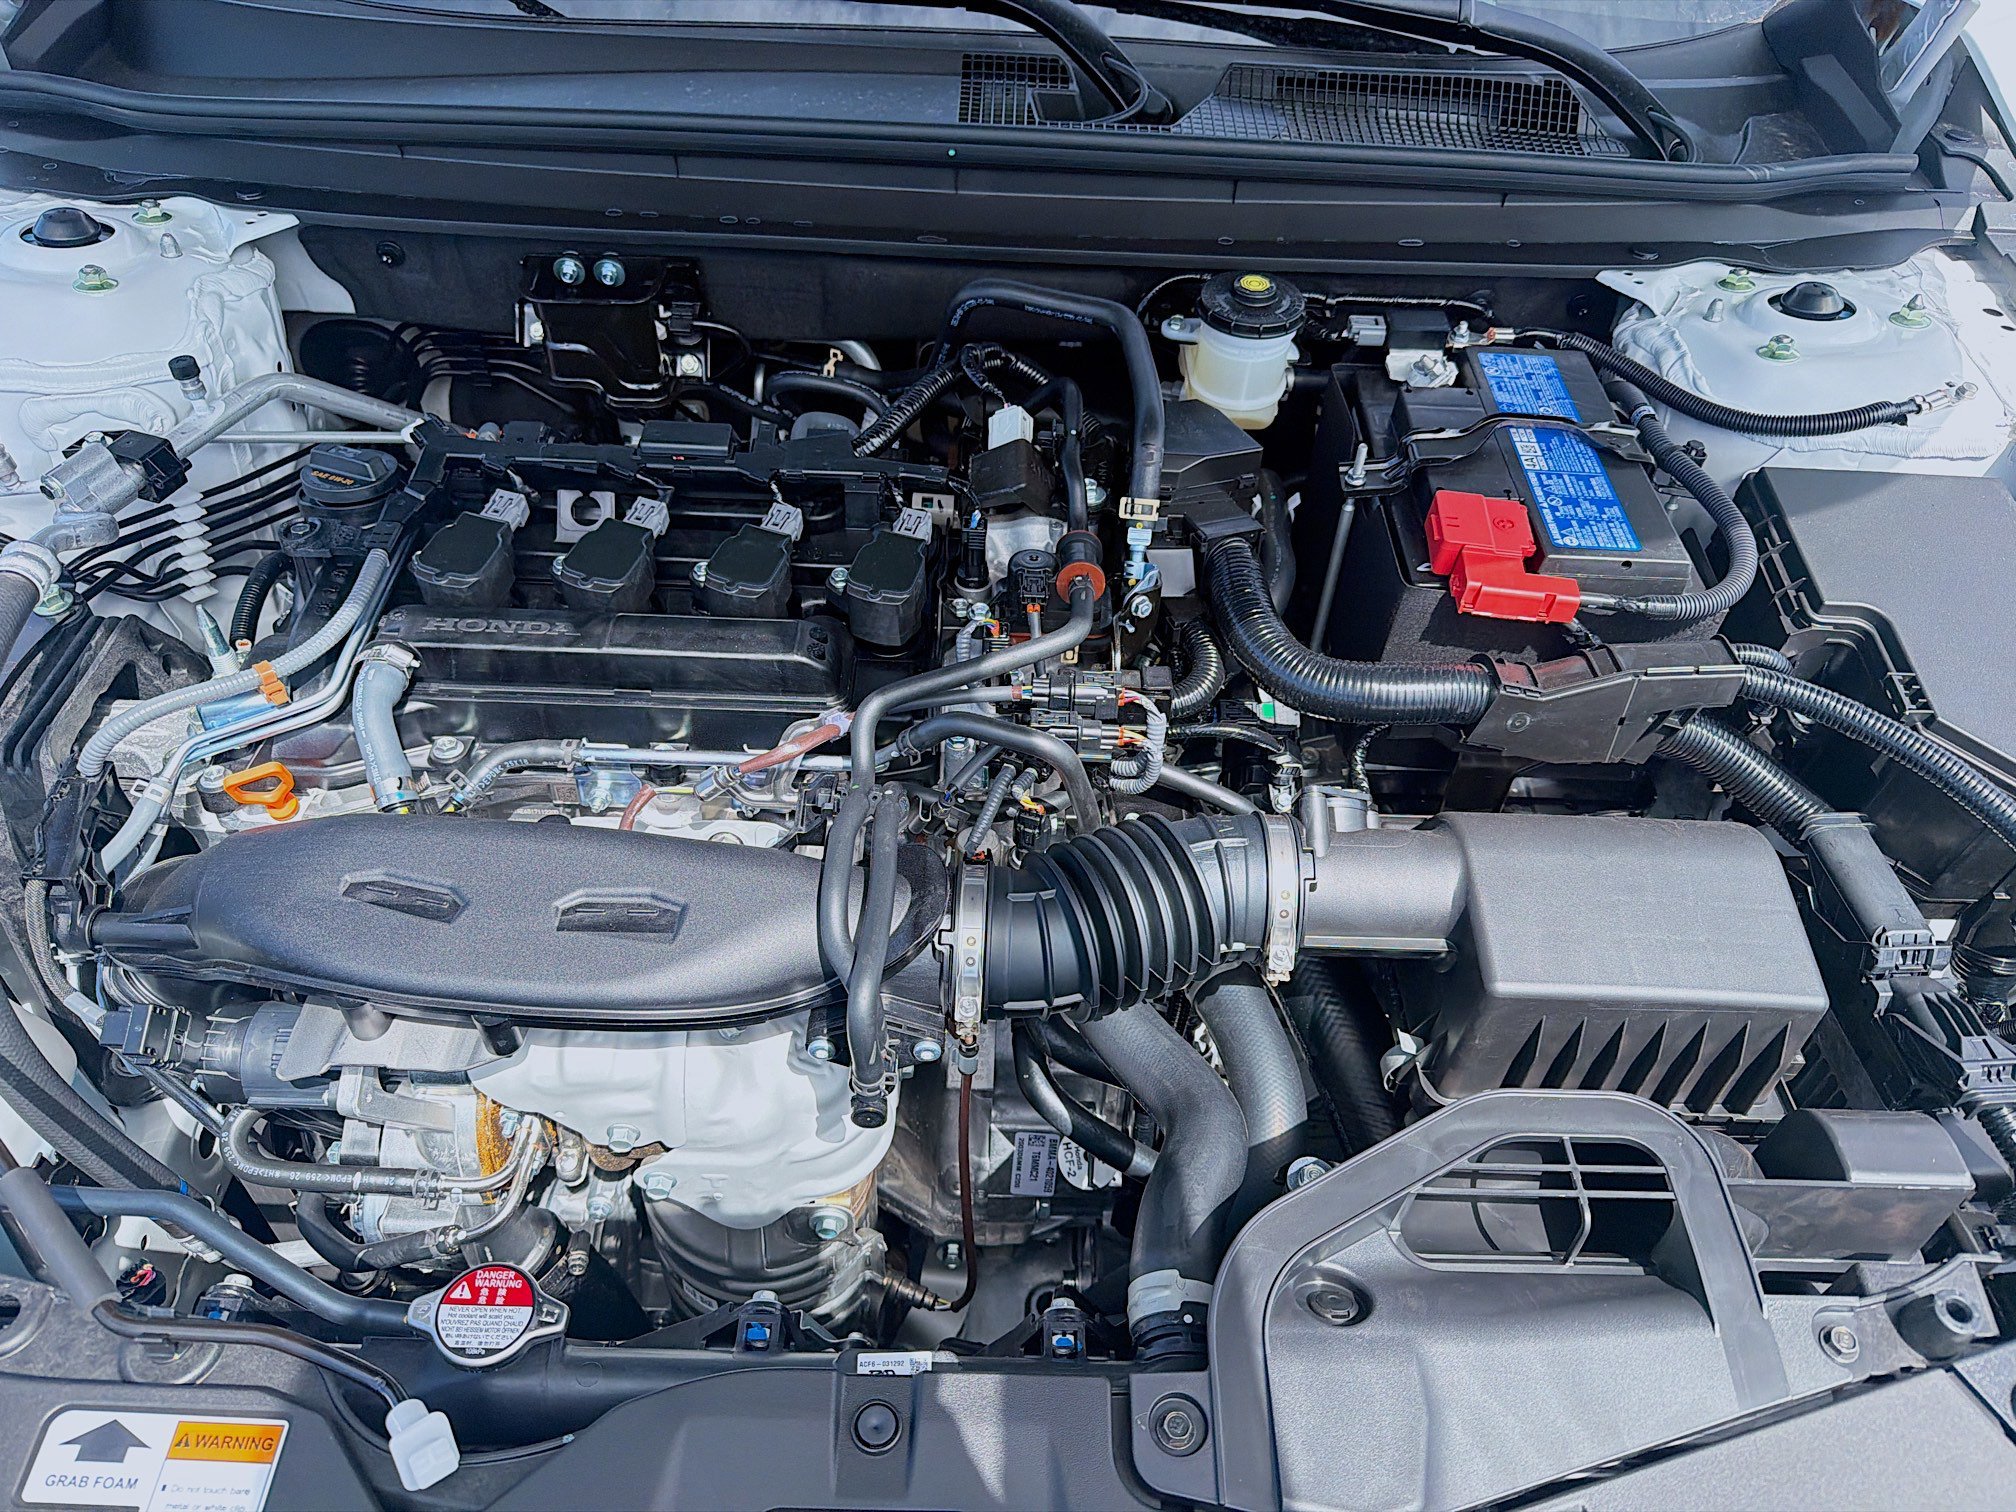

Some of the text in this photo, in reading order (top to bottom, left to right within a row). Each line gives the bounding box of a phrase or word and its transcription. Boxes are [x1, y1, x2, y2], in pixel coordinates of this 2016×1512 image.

[422, 617, 582, 636] HONDA
[1062, 1141, 1077, 1178] HCF-2
[1074, 1146, 1083, 1171] Honda
[475, 1279, 523, 1288] WARNUNG
[476, 1270, 516, 1280] DANGER
[195, 1433, 274, 1451] WARNING
[45, 1474, 139, 1490] GRAB FOAM
[171, 1484, 183, 1493] Do
[203, 1486, 227, 1494] touch
[230, 1485, 251, 1495] bare
